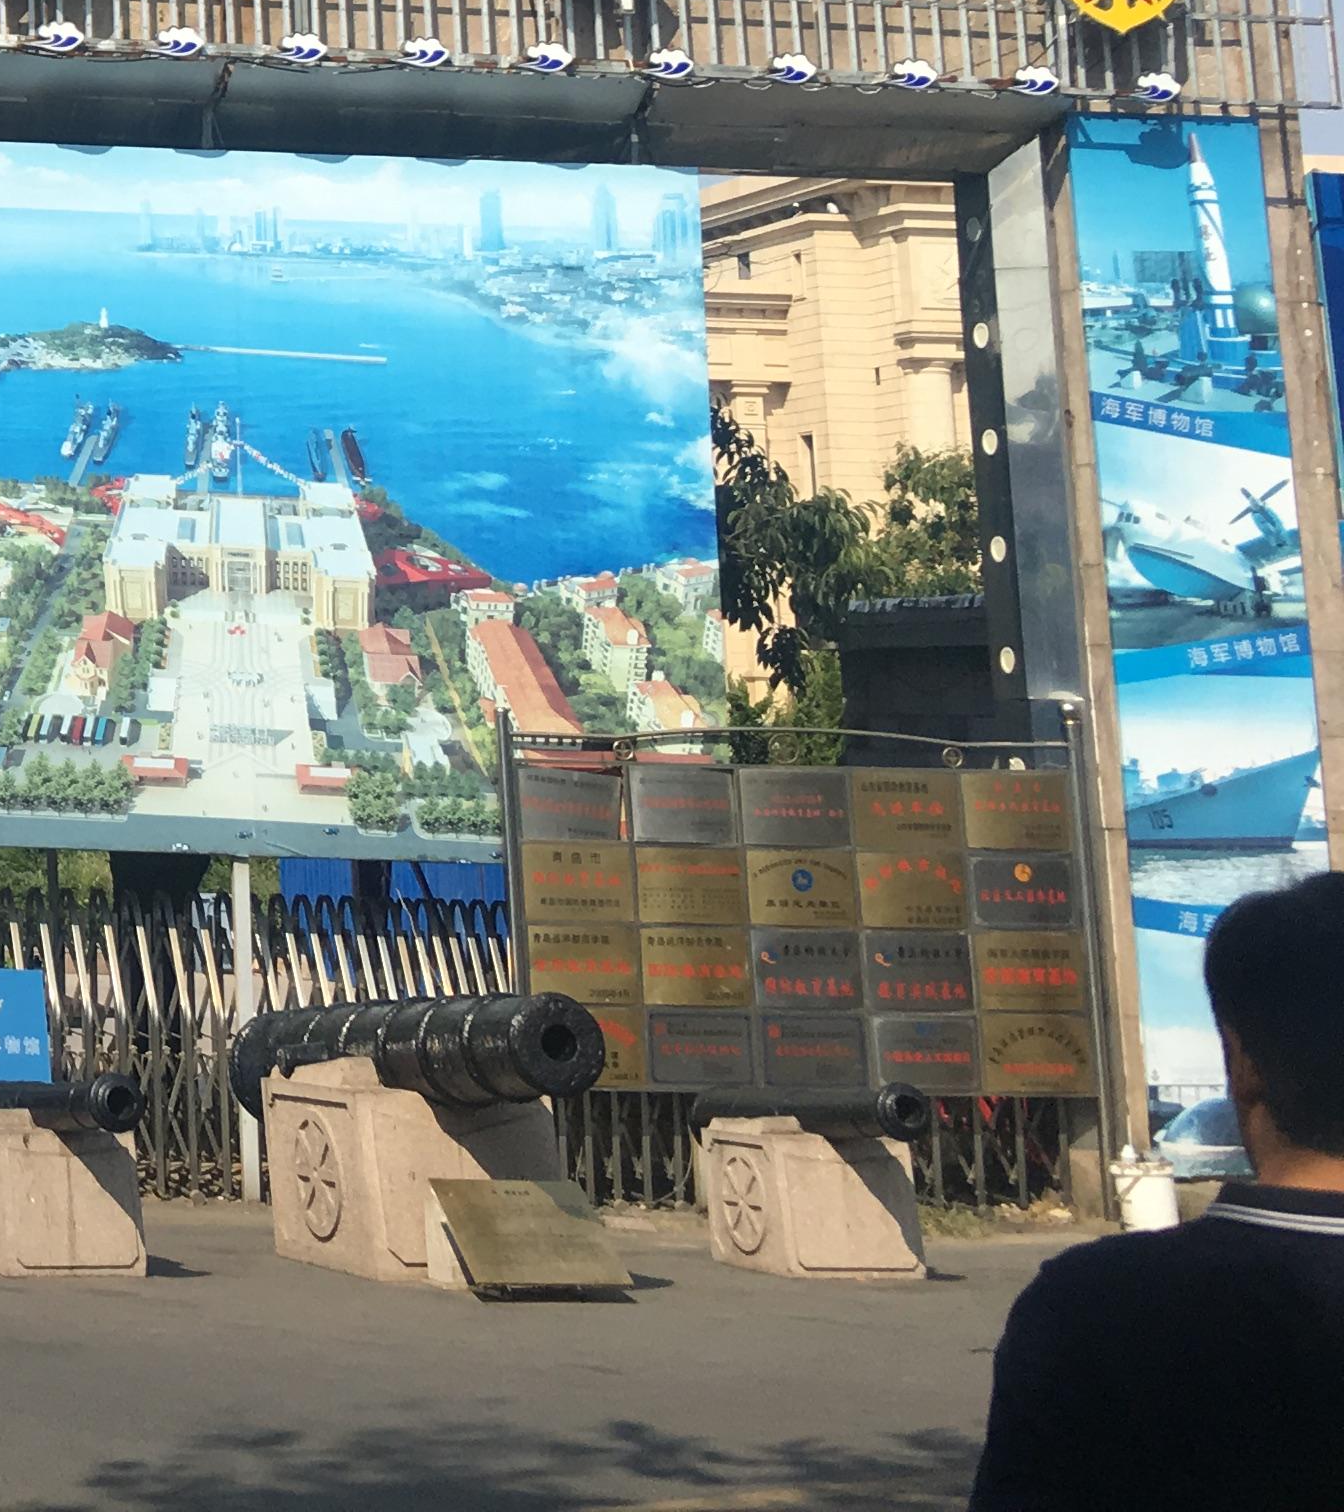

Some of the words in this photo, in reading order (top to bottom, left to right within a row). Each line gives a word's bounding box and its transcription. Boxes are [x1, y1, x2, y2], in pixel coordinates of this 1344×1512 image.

[1100, 397, 1214, 437] 海军博物馆
[1187, 632, 1301, 669] 海军博物馆
[1148, 809, 1174, 830] 105
[552, 851, 601, 865] 青岛市
